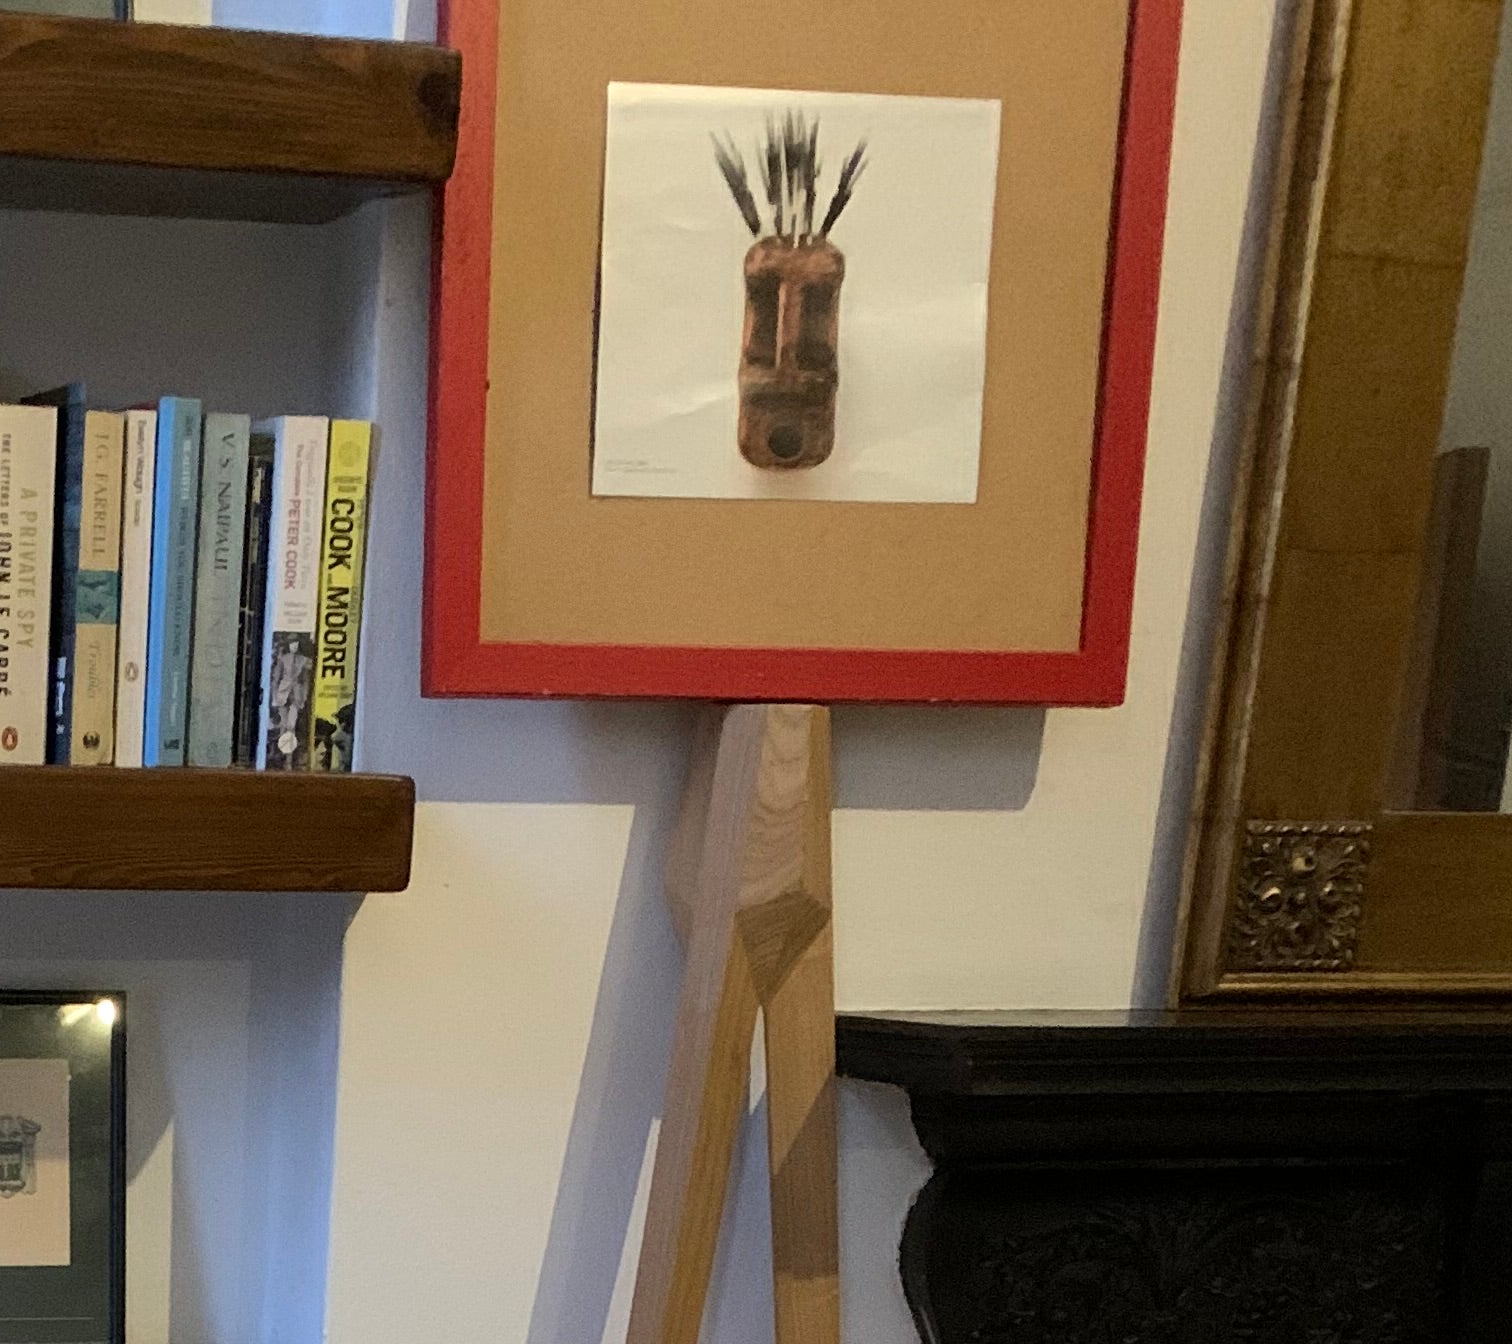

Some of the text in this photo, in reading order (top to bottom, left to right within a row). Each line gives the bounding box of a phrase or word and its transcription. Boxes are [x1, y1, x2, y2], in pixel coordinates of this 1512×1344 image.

[0, 432, 13, 455] THE
[0, 459, 12, 507] LETTERS
[0, 511, 10, 527] OF
[91, 471, 109, 560] FARRELL
[287, 498, 303, 546] PETER
[16, 487, 40, 650] A PRIVATE SPY
[284, 550, 299, 591] COOK
[322, 498, 356, 680] COOK MOORE
